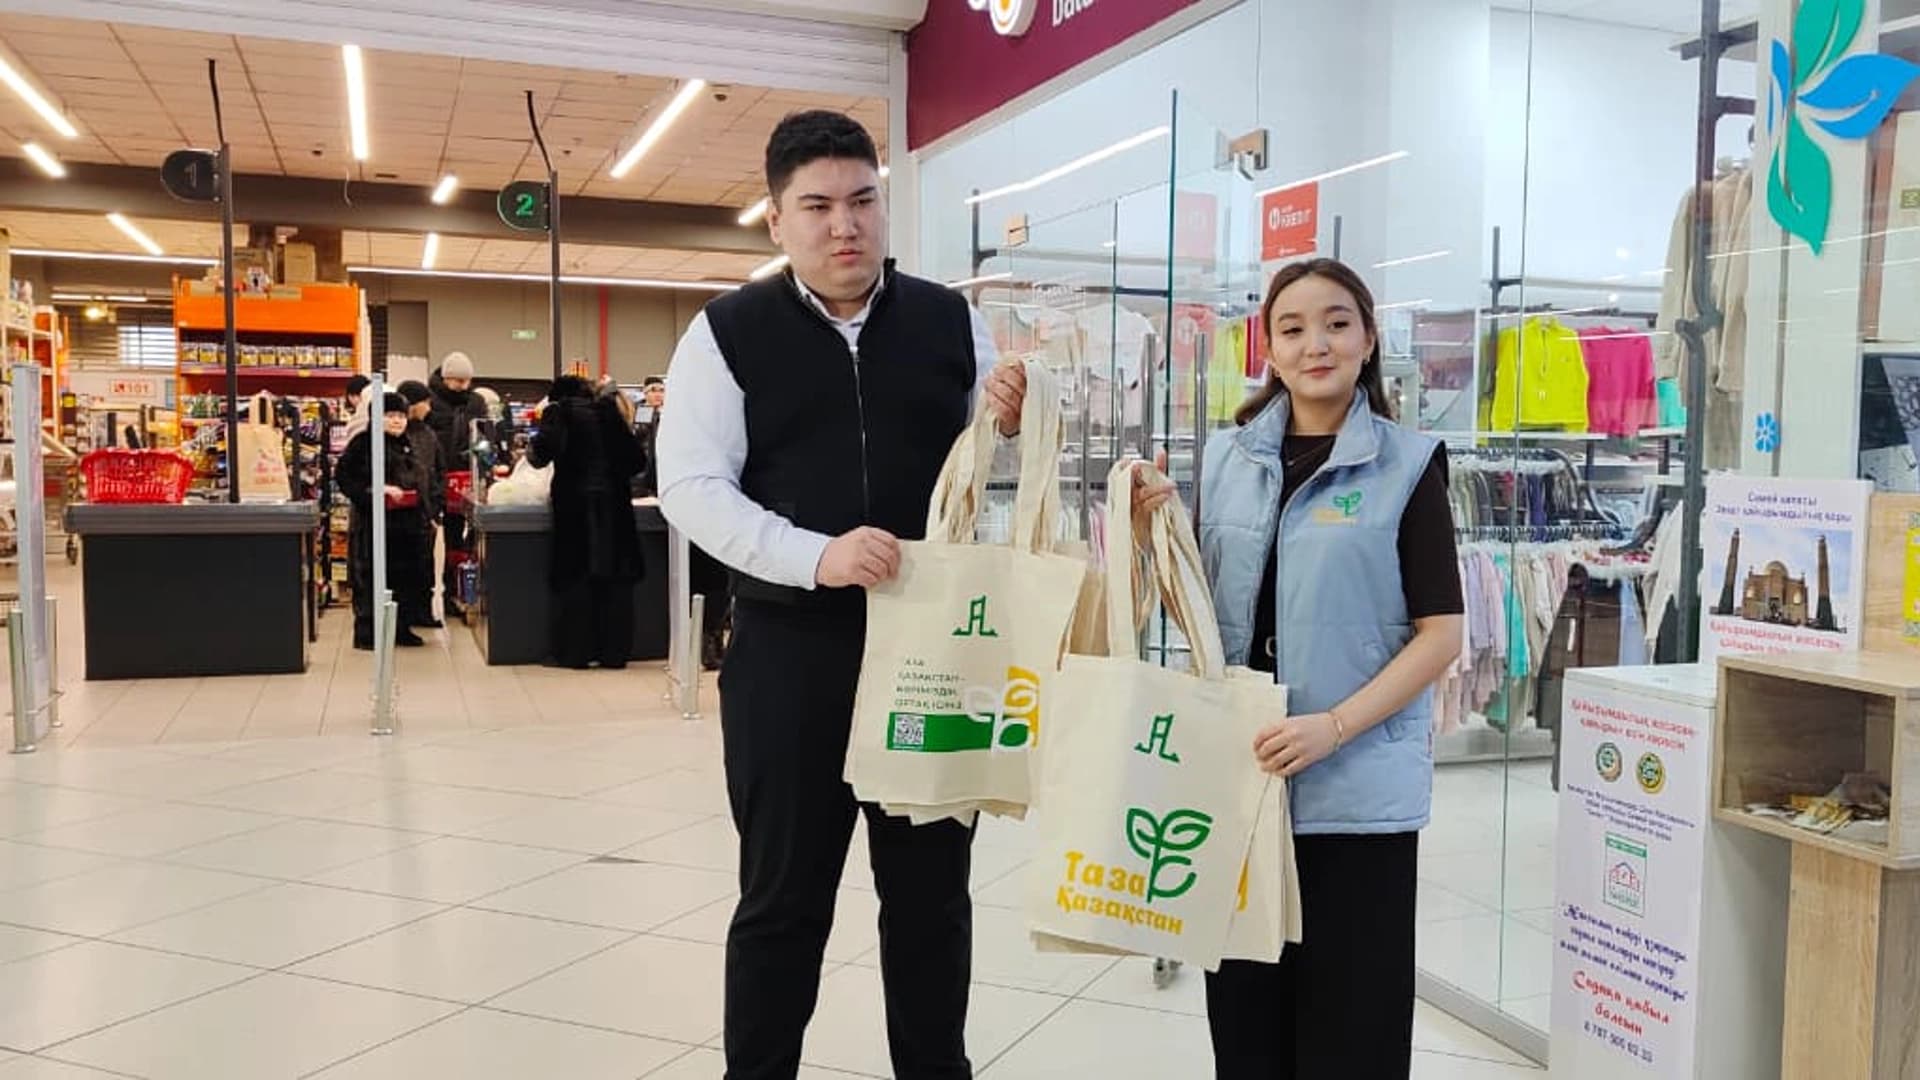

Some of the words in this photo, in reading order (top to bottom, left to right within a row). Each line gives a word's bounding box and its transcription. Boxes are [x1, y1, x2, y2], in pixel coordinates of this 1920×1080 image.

[183, 162, 197, 188] 1
[515, 193, 534, 216] 2
[1065, 851, 1145, 898] Таза
[1057, 886, 1184, 935] Қазақстан
[1573, 970, 1622, 1001] Садақа
[1625, 996, 1670, 1025] қабыл
[1595, 1003, 1642, 1035] болсын
